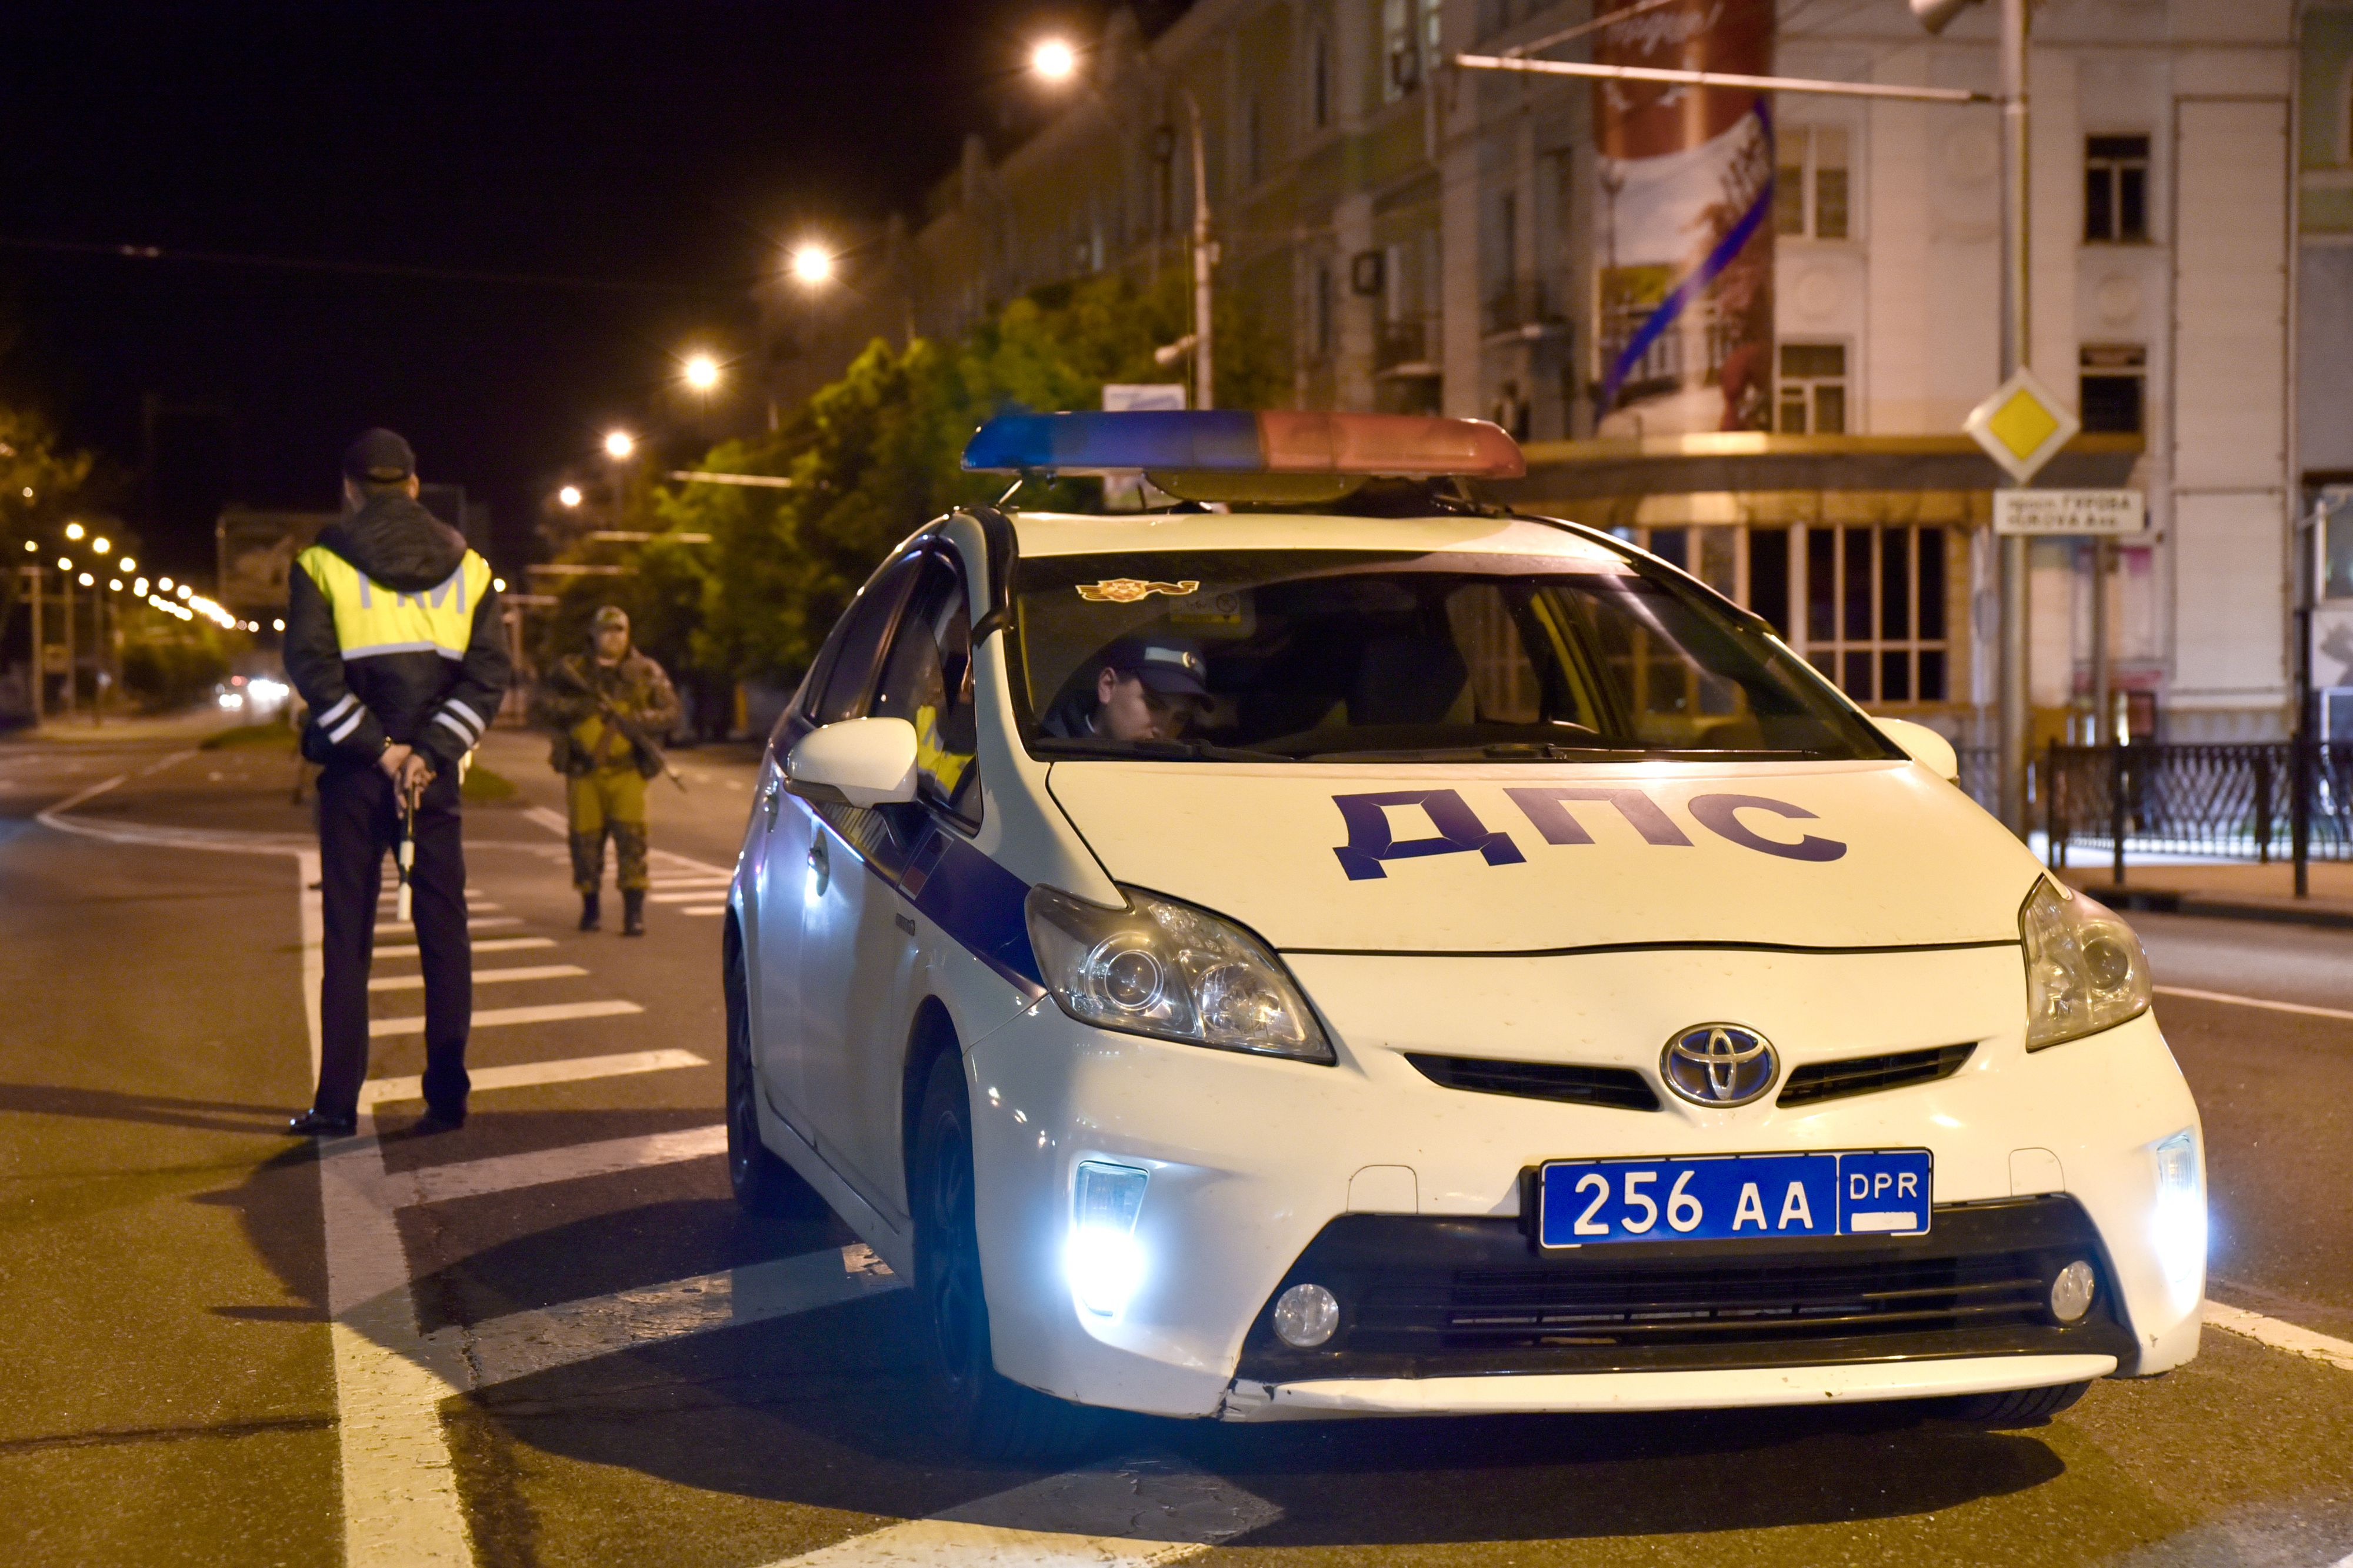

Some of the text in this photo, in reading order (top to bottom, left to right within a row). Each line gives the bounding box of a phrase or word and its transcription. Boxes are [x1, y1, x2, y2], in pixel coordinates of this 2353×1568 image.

[1332, 788, 1847, 880] ДПС
[1574, 1170, 1704, 1235] 256
[1849, 1172, 1918, 1200] DPR
